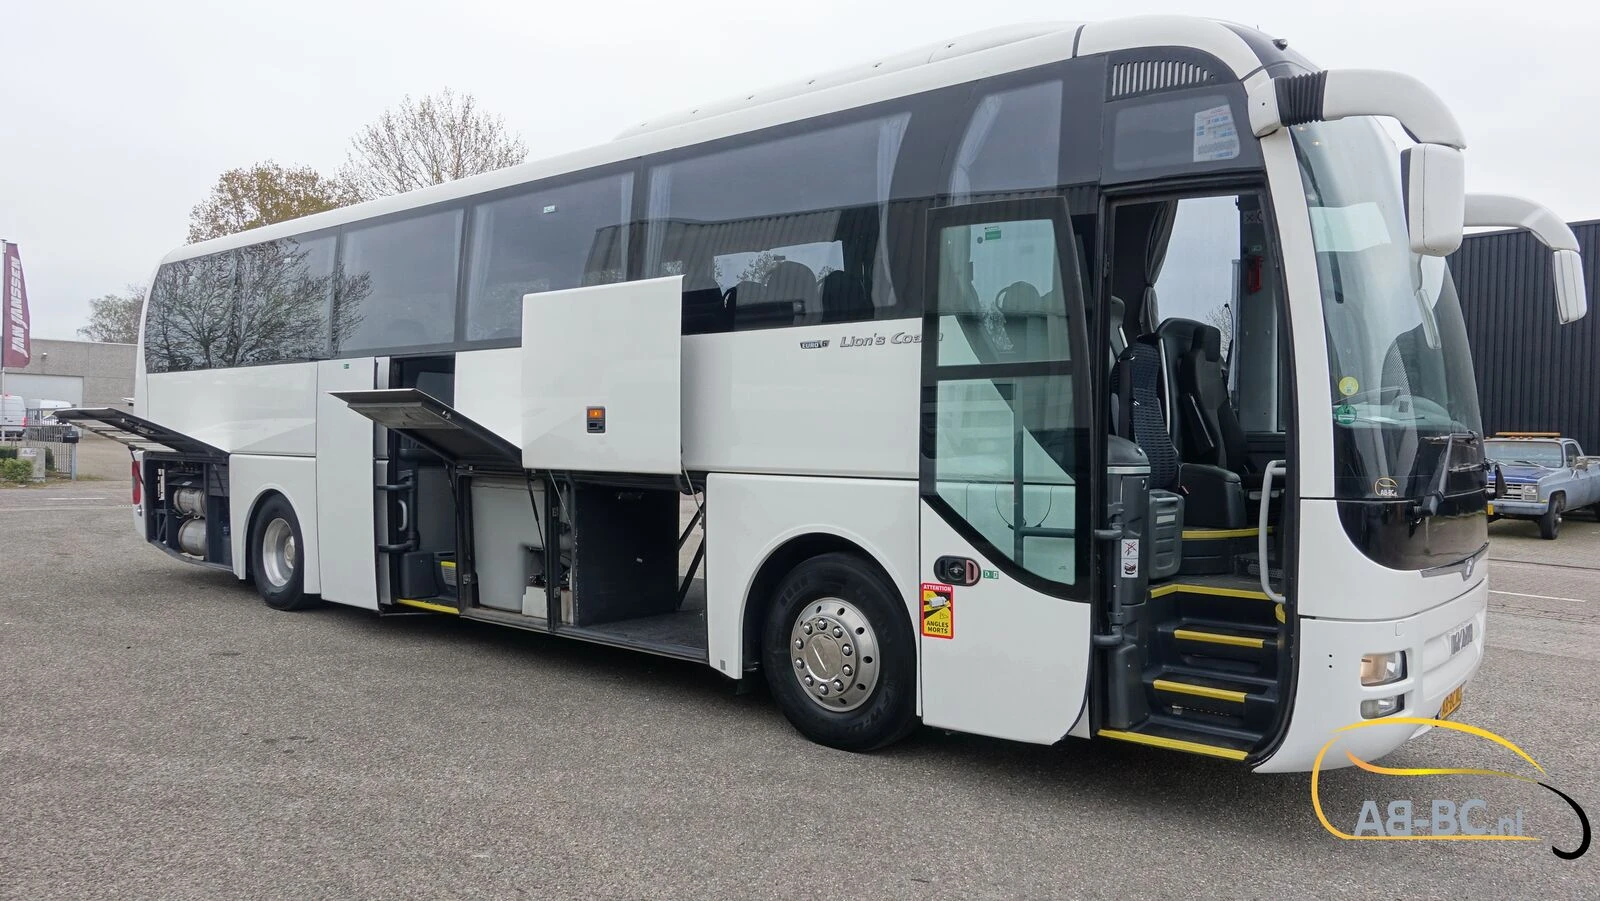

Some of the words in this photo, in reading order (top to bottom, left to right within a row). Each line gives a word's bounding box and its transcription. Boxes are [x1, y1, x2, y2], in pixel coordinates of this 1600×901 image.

[11, 256, 28, 329] JANSSEN
[12, 325, 28, 358] JAN
[840, 333, 886, 347] Lion's
[891, 332, 943, 344] Coa
